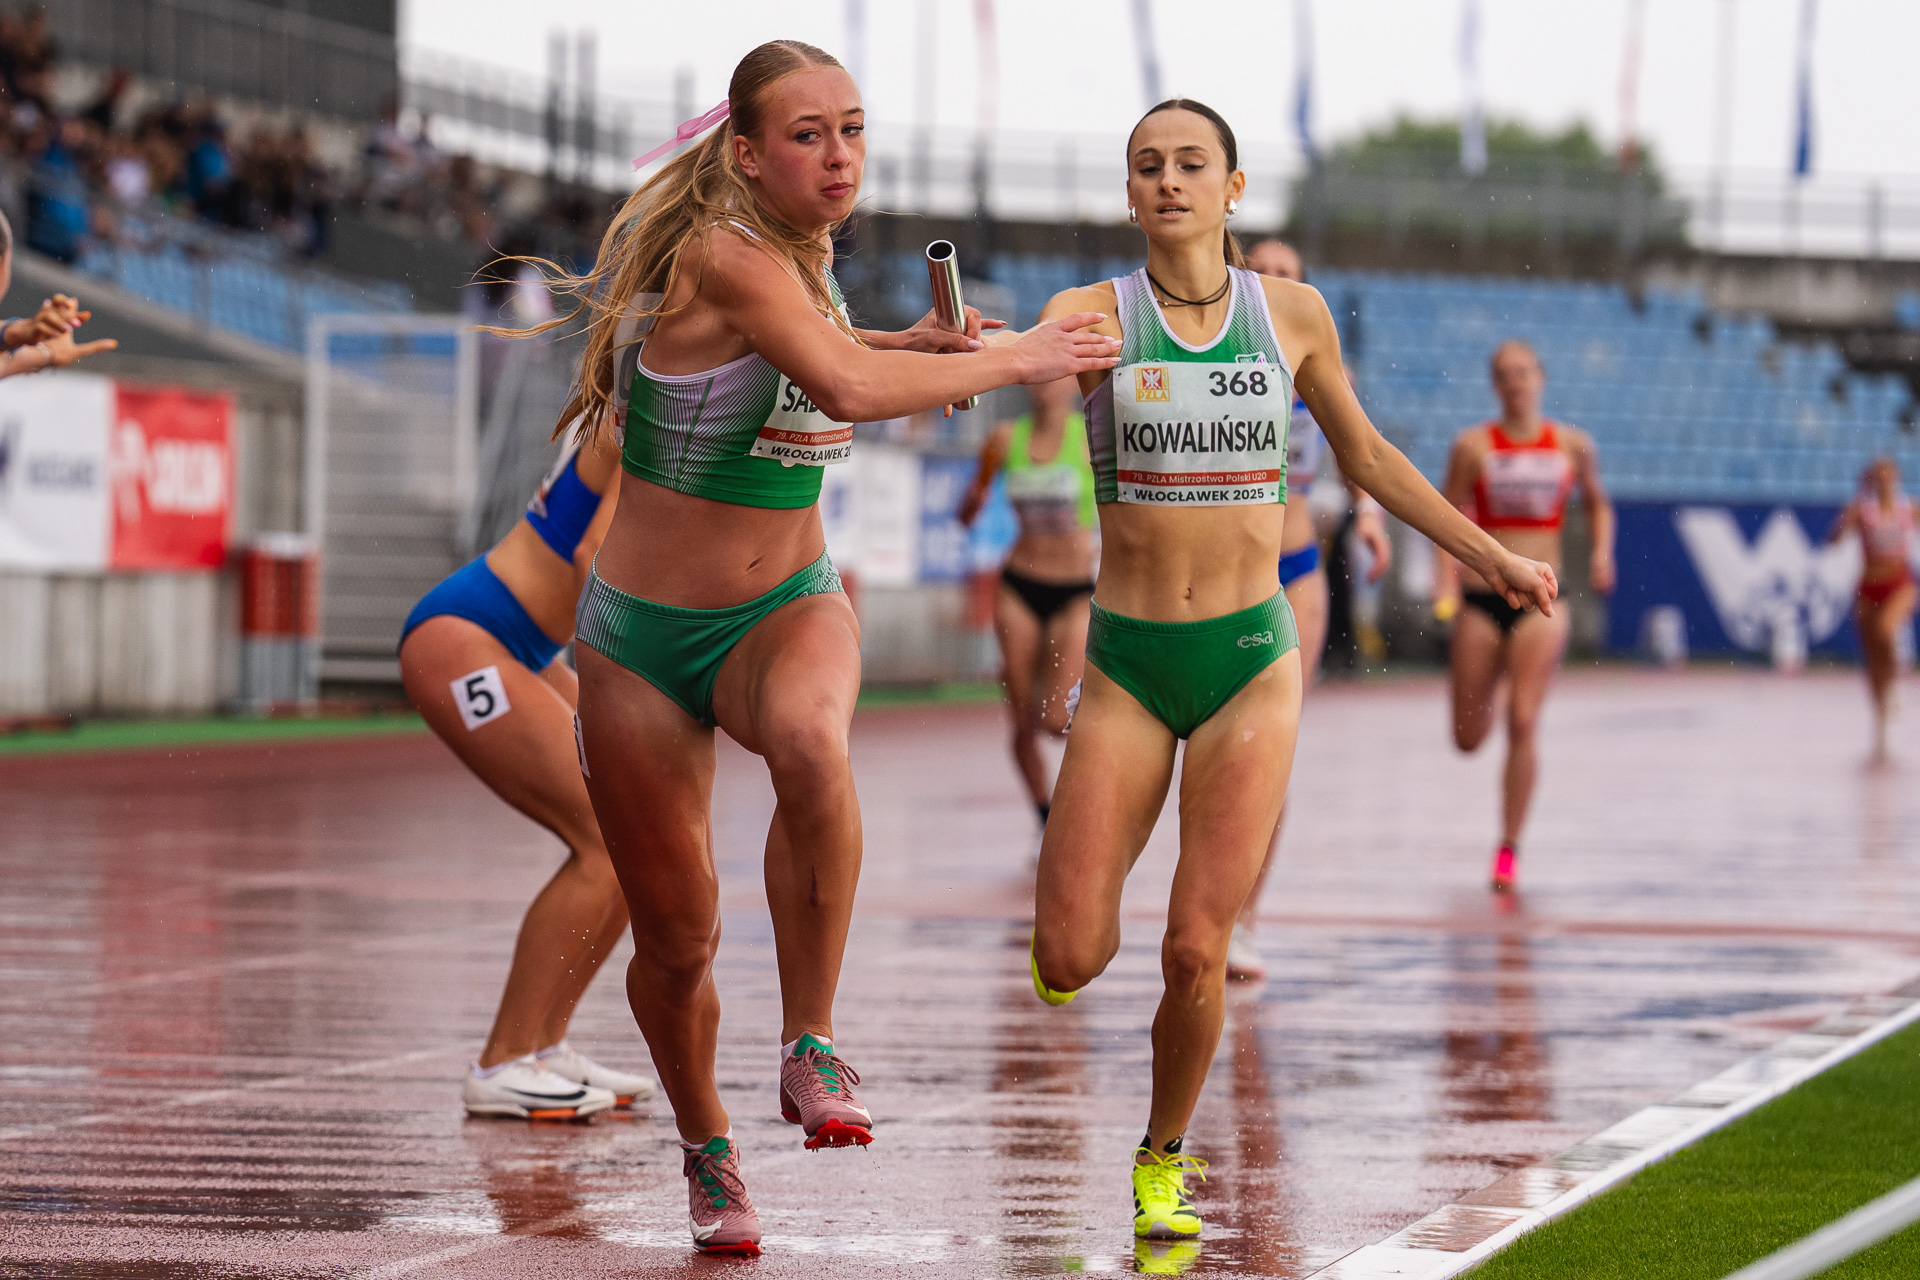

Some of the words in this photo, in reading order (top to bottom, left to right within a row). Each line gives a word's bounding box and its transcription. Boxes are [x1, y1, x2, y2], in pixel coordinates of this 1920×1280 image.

[1208, 370, 1268, 397] 368
[1138, 390, 1168, 400] PZLA
[776, 431, 788, 441] 79.
[789, 434, 808, 443] PZLA
[1122, 414, 1277, 453] KOWALIŃSKA
[771, 446, 843, 461] WŁOCŁAWEK
[1132, 472, 1145, 481] 79.
[1146, 474, 1167, 483] PZLA
[1169, 475, 1224, 484] Mistrzostwa
[1226, 473, 1251, 482] Polski
[1252, 471, 1267, 481] U20
[1134, 488, 1229, 502] WŁOCŁAWEK
[1232, 487, 1265, 500] 2025
[466, 675, 495, 718] 5
